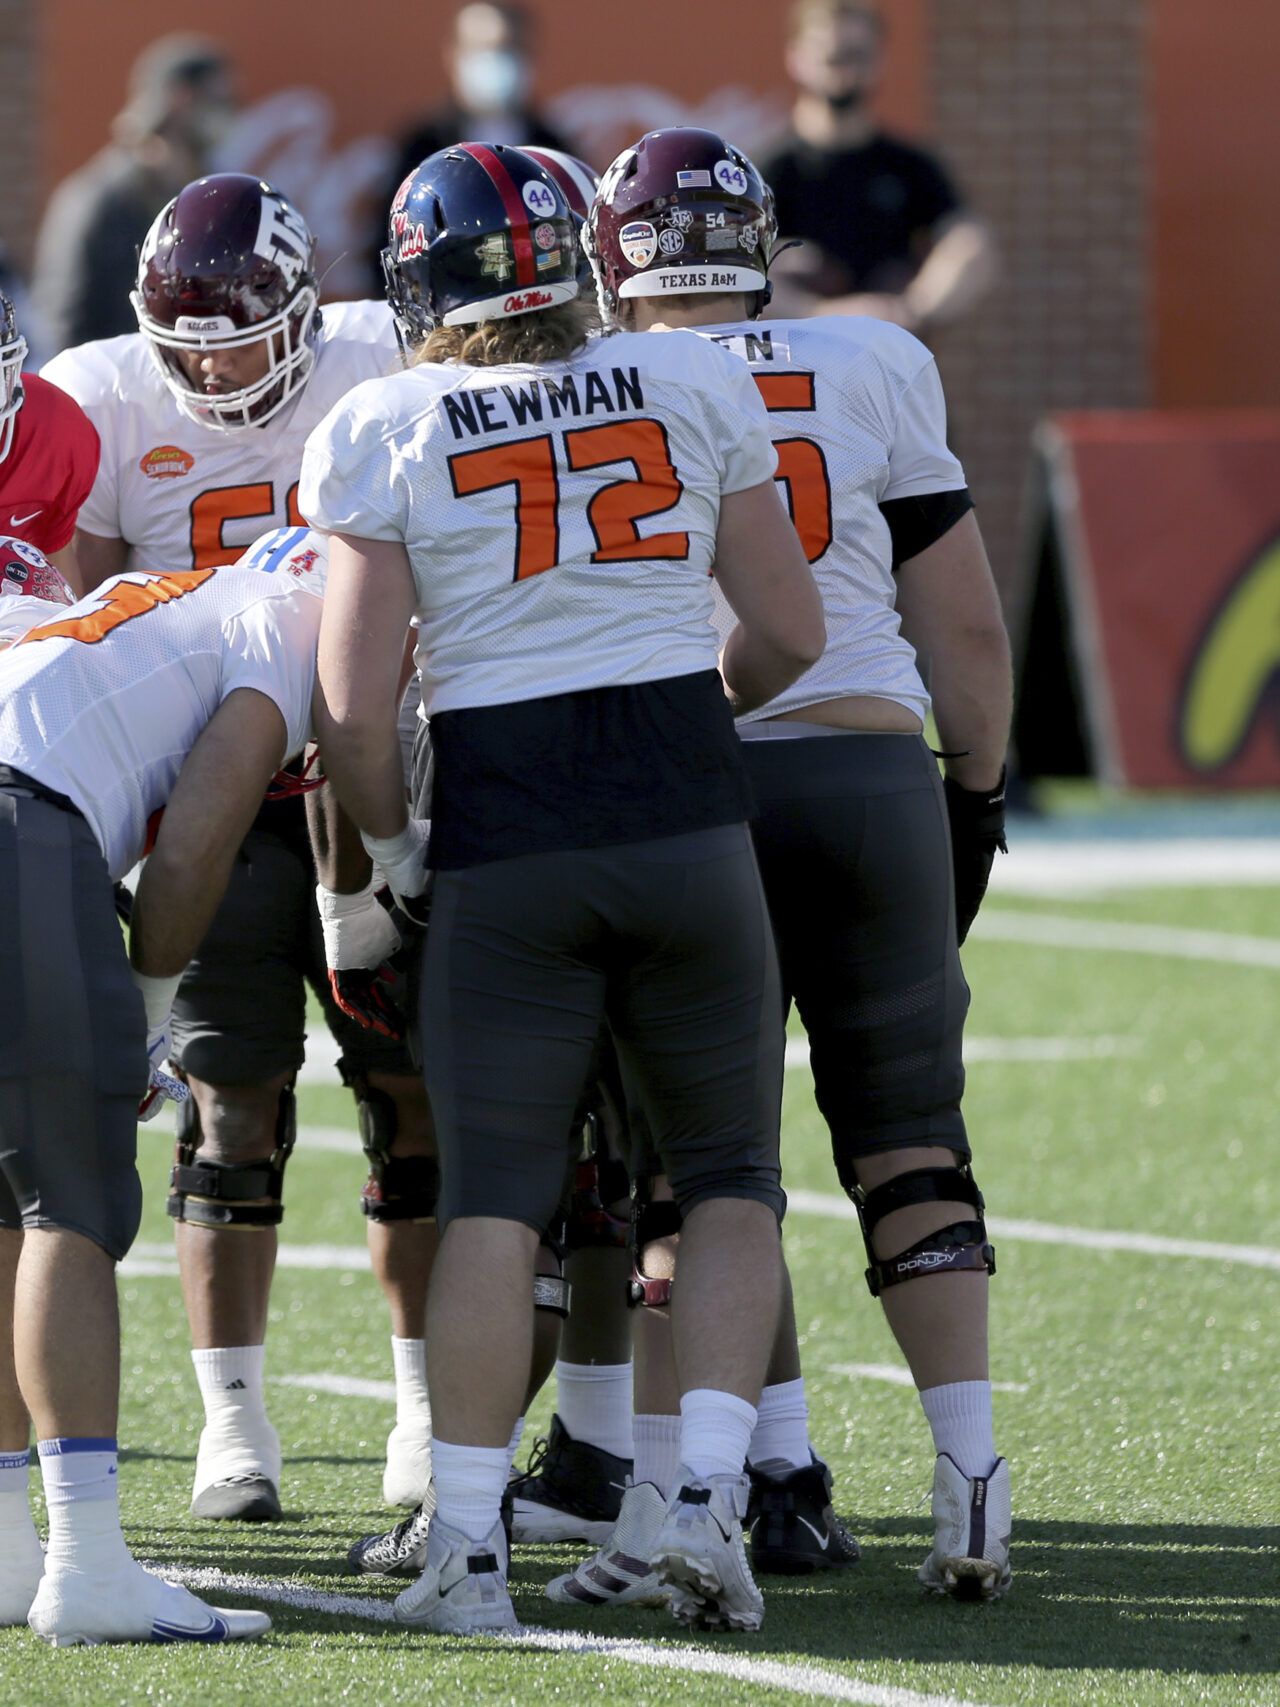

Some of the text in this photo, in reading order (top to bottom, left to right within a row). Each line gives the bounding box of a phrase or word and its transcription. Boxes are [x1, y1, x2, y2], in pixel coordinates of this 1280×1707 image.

[719, 167, 745, 188] 44
[529, 189, 553, 208] 44
[706, 212, 725, 227] 54
[661, 231, 682, 252] SEC
[659, 273, 737, 288] TEXAS A&M
[504, 290, 553, 313] Ole Miss
[442, 367, 645, 440] NEWMAN
[447, 418, 689, 584] 72
[16, 541, 43, 566] 44
[287, 564, 303, 577] P6
